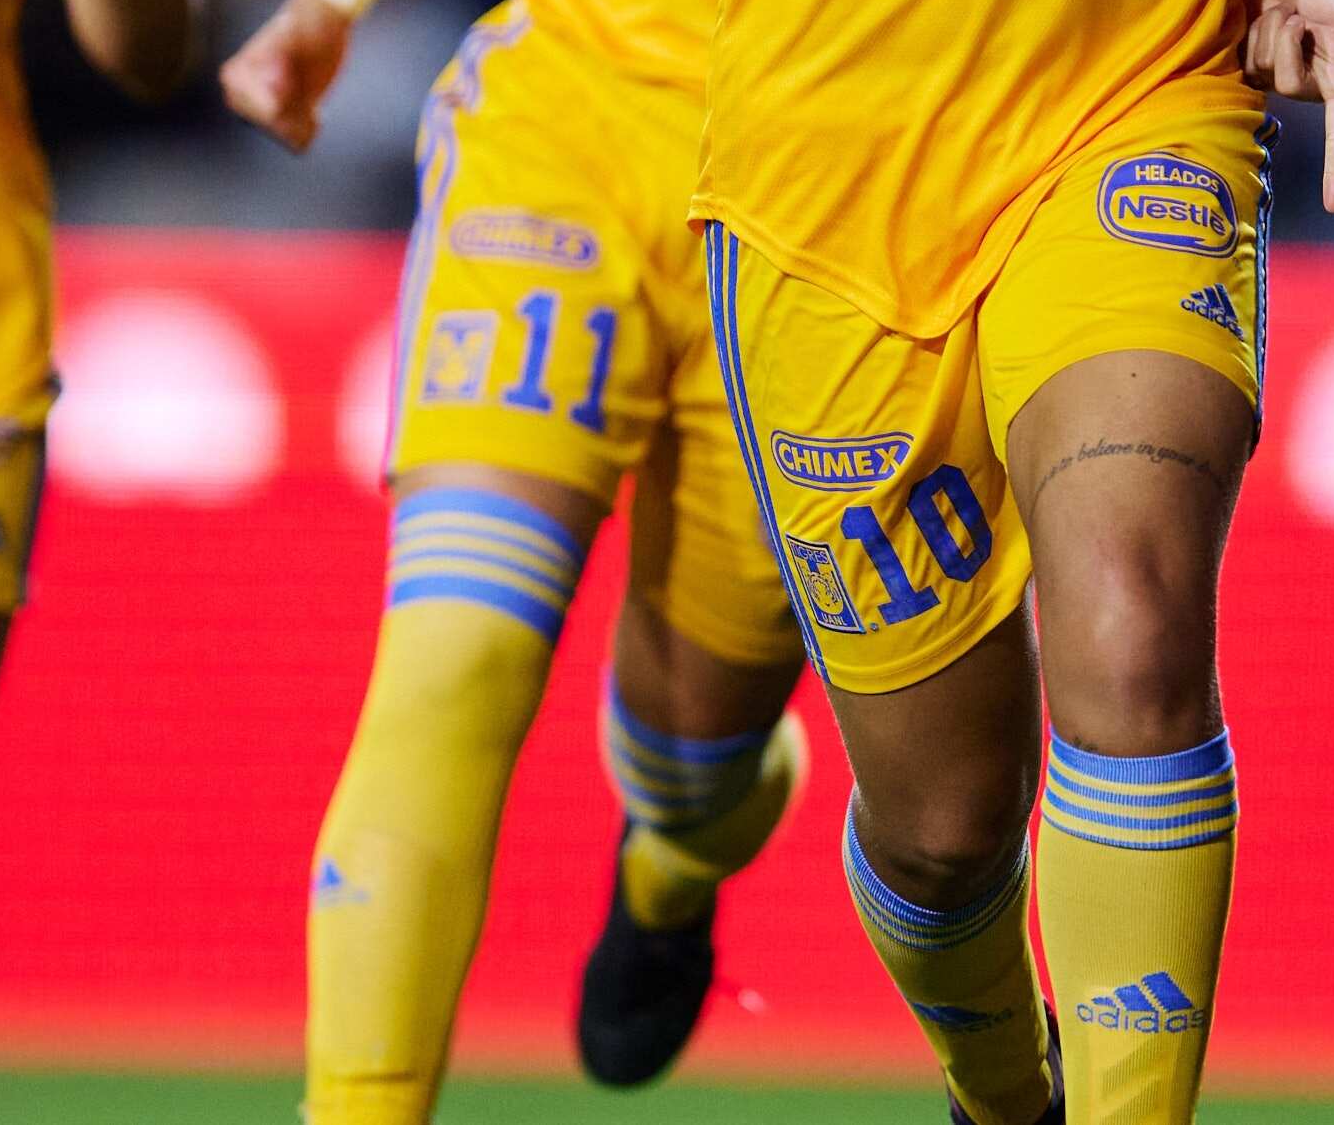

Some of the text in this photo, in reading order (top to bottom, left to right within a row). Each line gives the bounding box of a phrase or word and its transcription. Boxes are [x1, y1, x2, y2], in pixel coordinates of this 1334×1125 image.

[1134, 164, 1220, 193] HELADOS
[504, 288, 618, 435] 11
[777, 442, 900, 479] CHIMEX
[839, 462, 994, 626] 10
[1076, 1002, 1206, 1034] adidas
